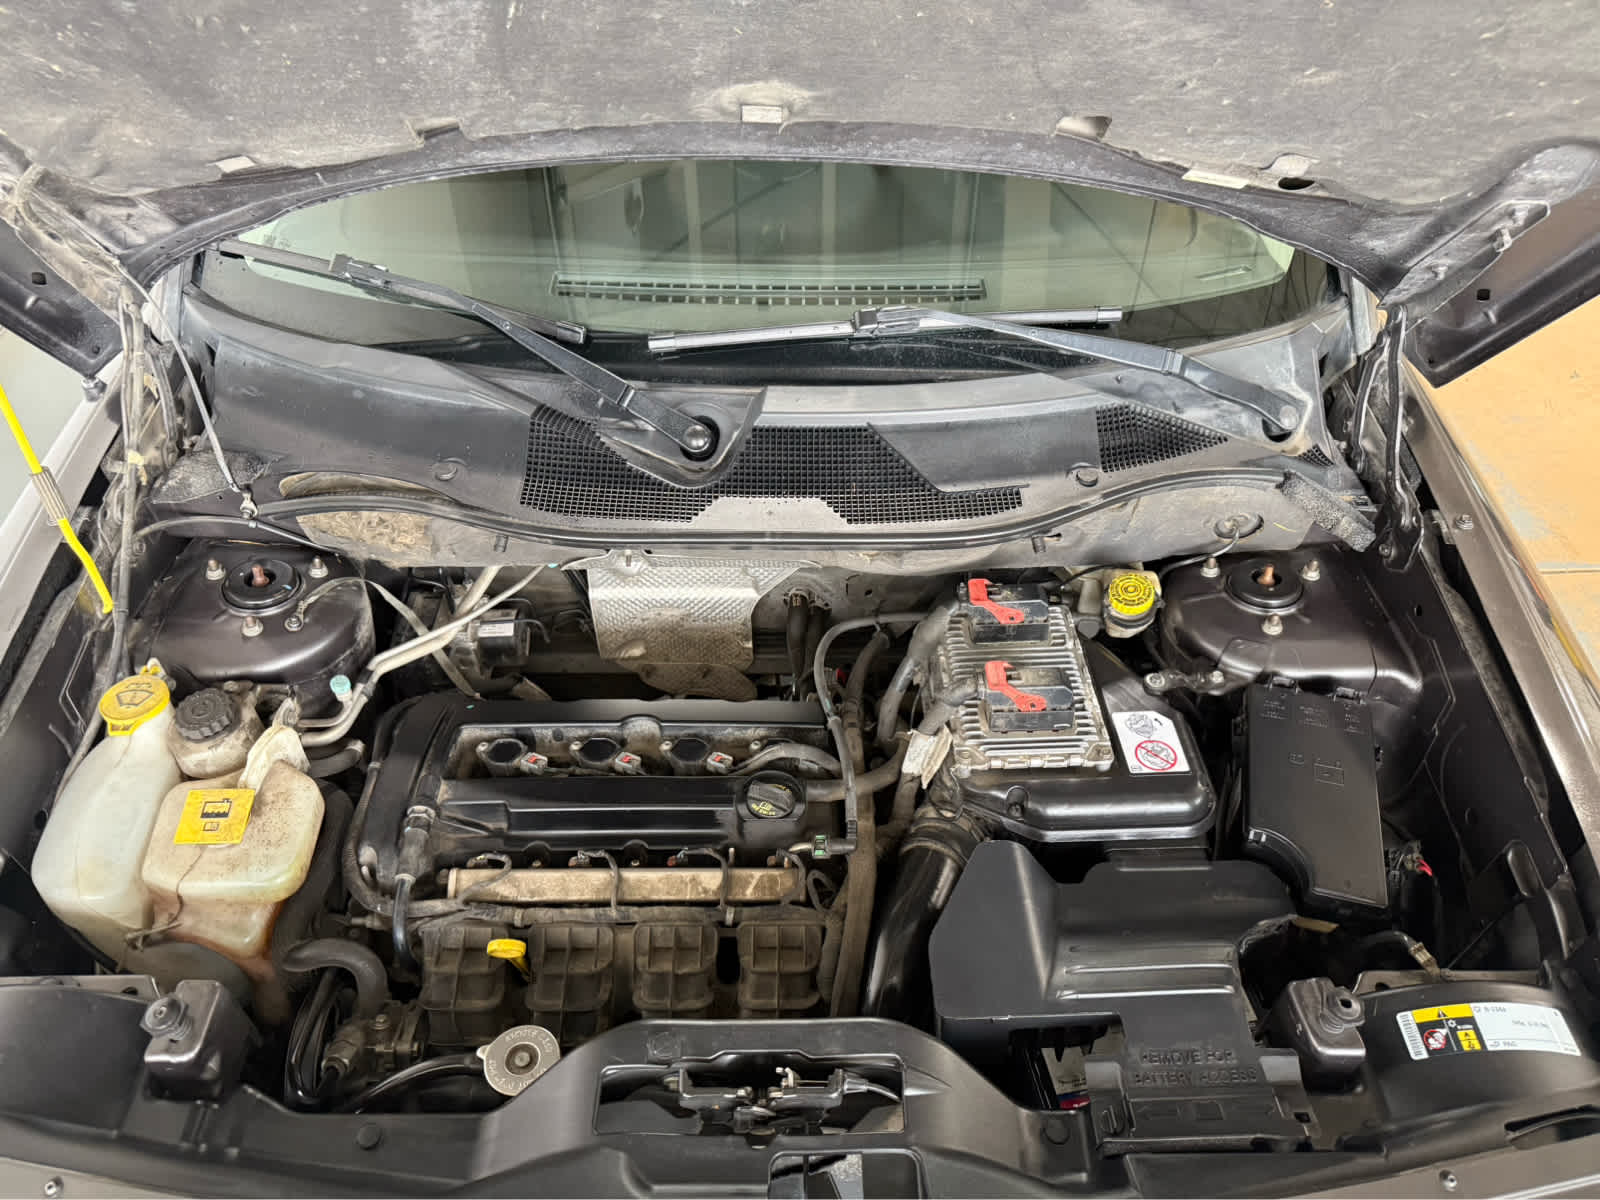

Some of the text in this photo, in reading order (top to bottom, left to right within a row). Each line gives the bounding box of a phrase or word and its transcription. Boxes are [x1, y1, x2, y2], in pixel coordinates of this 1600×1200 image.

[1140, 1049, 1238, 1065] REMOVE FOR
[1135, 1068, 1257, 1086] BATTERY ACCESS
